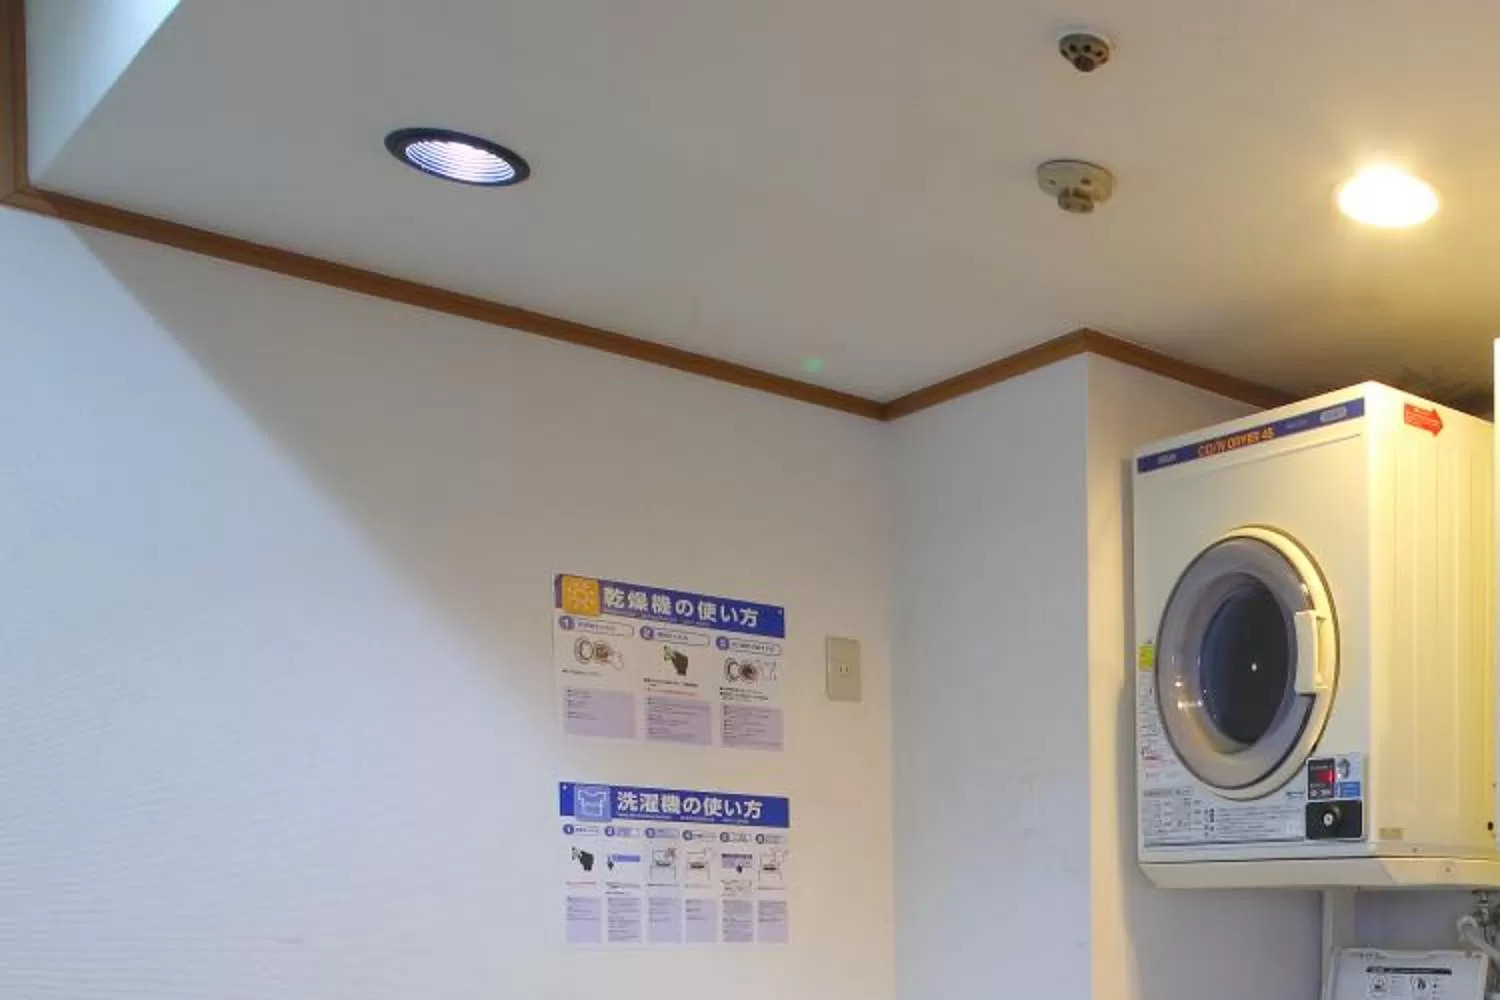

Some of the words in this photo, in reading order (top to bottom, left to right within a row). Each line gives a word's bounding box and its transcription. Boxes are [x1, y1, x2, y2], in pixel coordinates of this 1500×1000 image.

[603, 587, 759, 628] 乾燥機の使い方
[617, 791, 763, 819] 洗濯機の使い方
